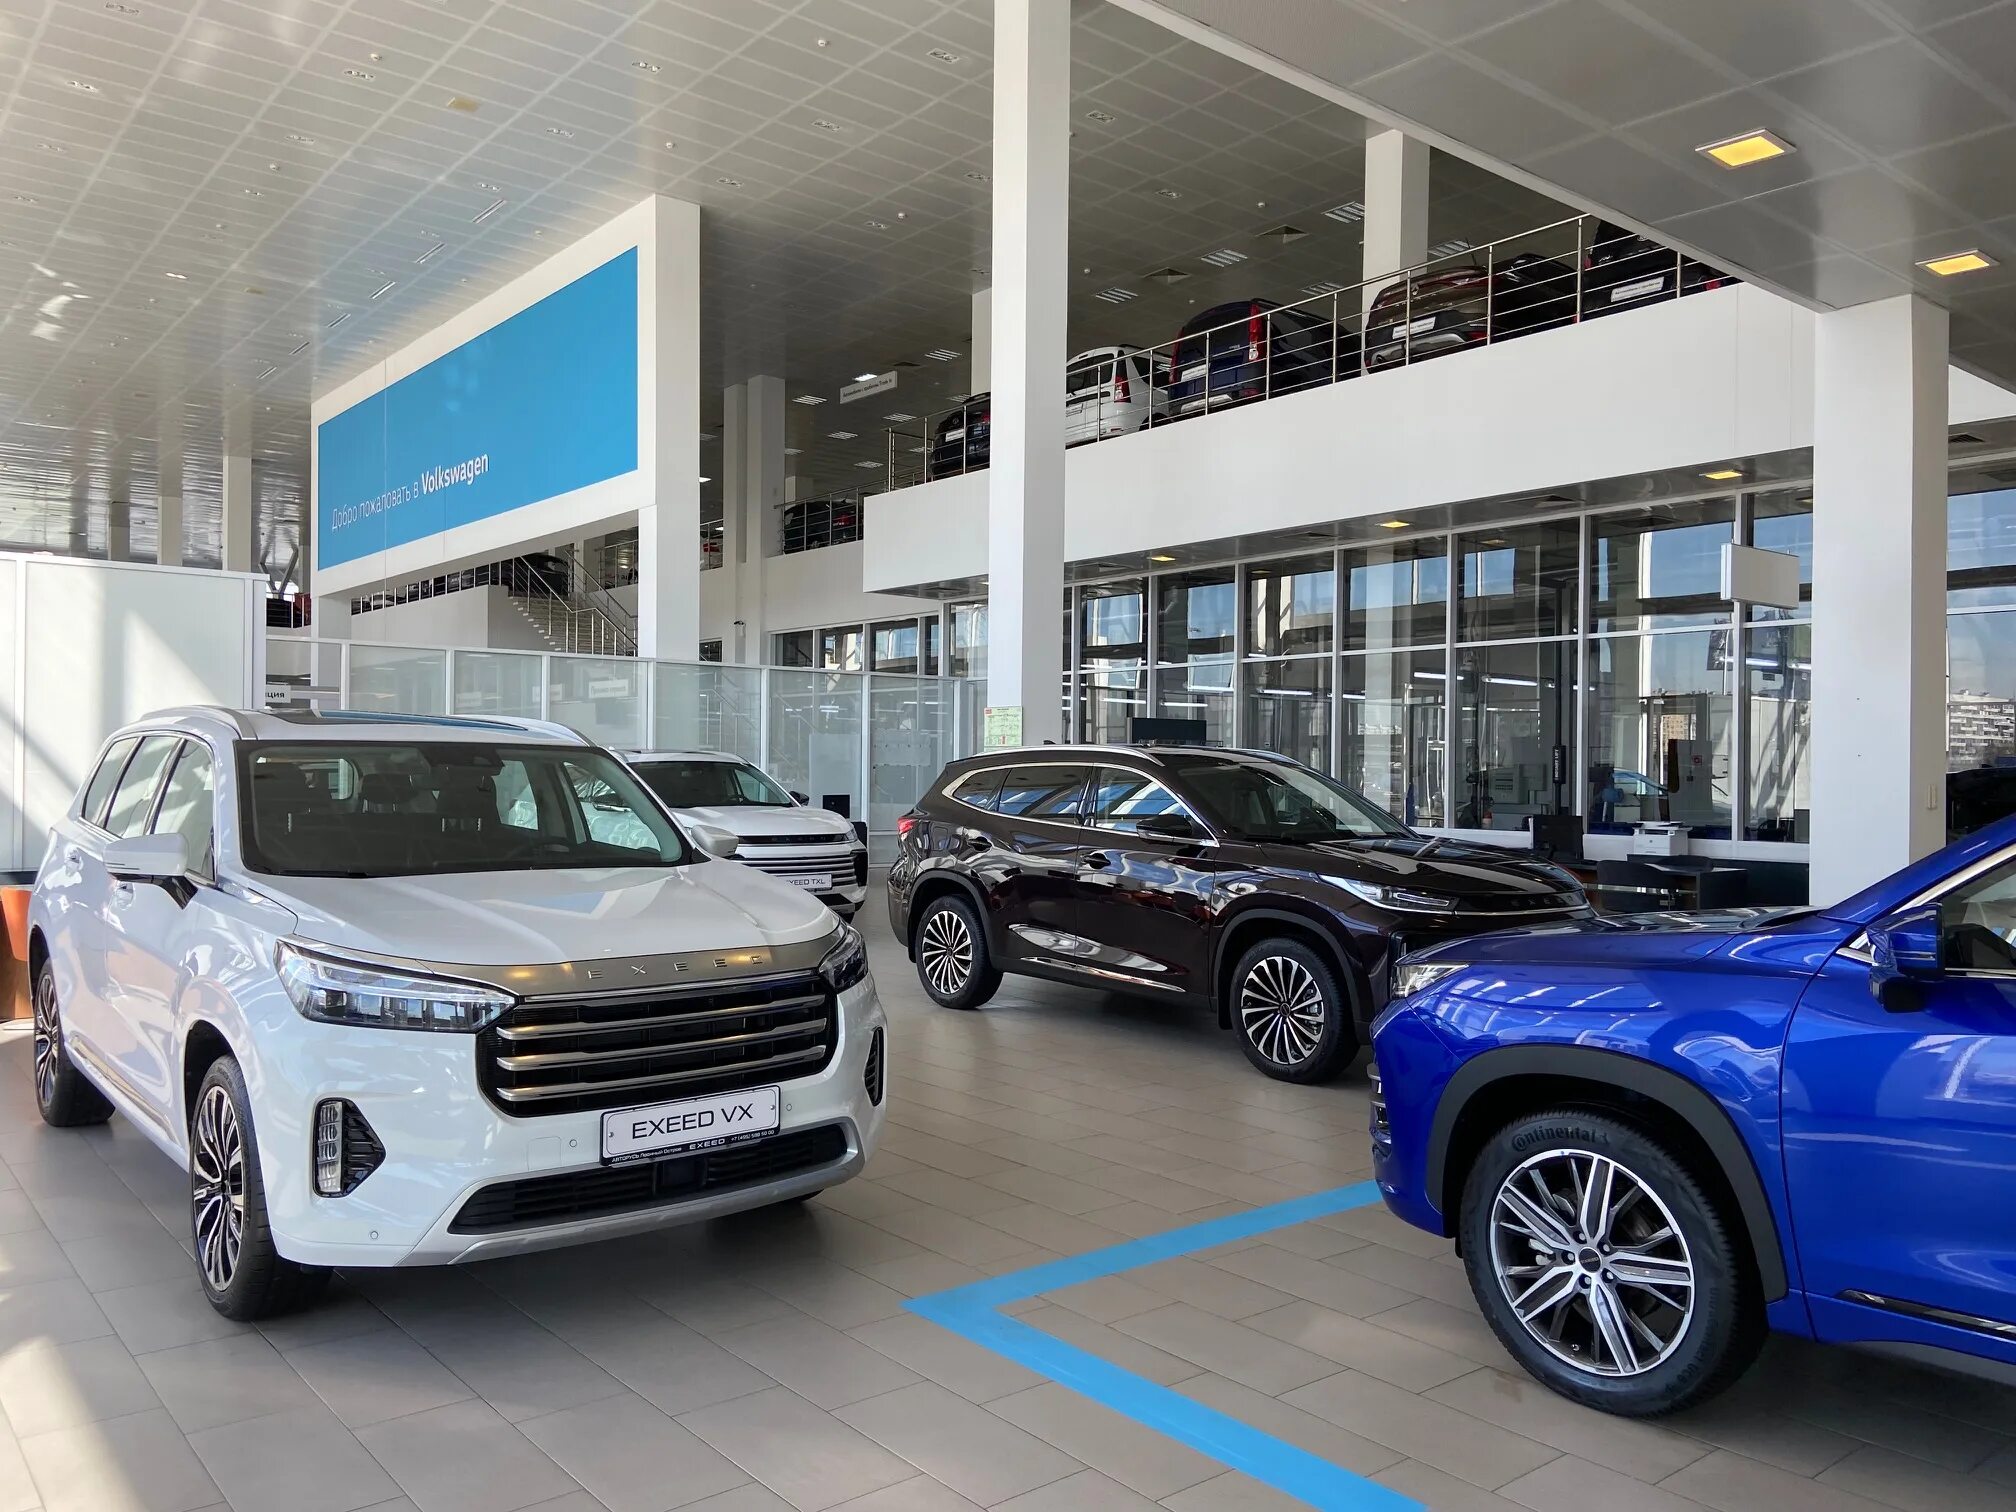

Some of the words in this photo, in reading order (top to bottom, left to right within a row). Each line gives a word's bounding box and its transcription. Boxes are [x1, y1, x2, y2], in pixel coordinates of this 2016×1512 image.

[332, 503, 358, 531] Добро
[360, 486, 411, 518] пожаловать
[413, 481, 419, 498] в
[421, 453, 490, 495] Volkswagen
[632, 1110, 715, 1140] EXEED
[721, 1103, 753, 1123] VX
[689, 1138, 726, 1150] EXEED
[1512, 1125, 1596, 1152] Continental
